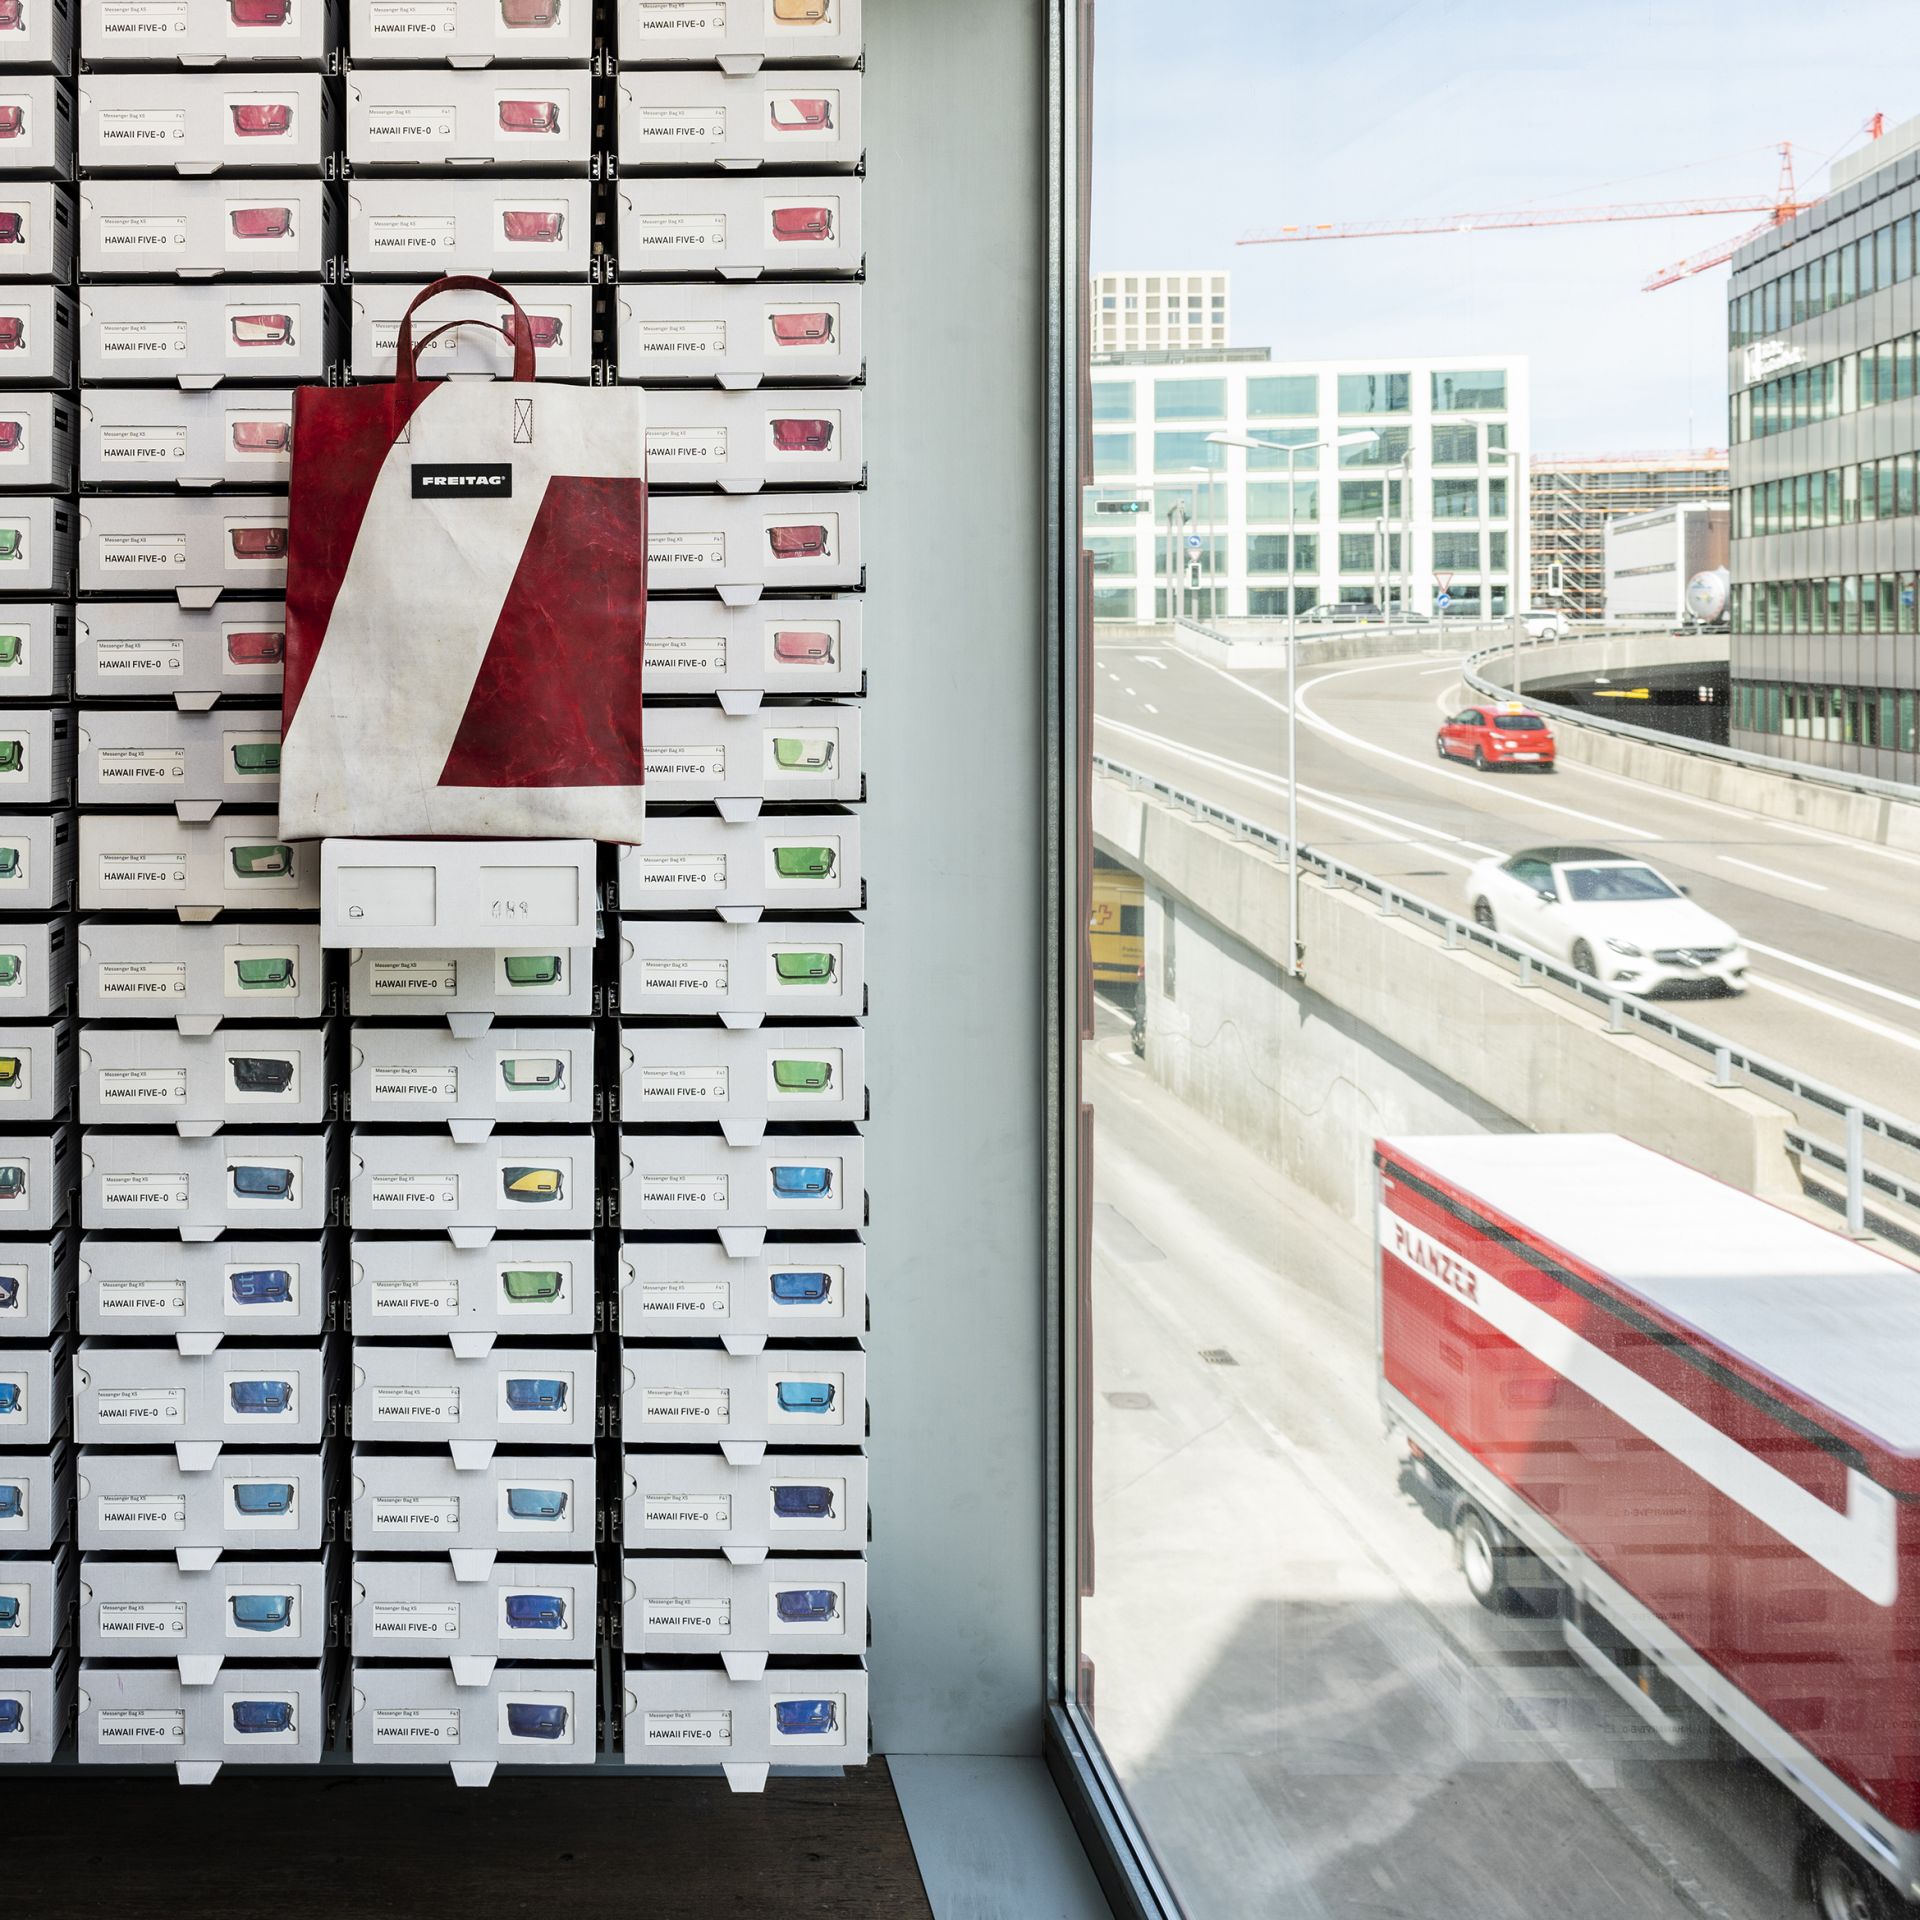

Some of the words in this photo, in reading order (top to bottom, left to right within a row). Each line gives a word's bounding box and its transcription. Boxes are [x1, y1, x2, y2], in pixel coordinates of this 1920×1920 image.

[105, 24, 136, 32] HAWAII
[643, 21, 674, 29] HAWAII
[643, 236, 674, 244] HAWAII
[422, 476, 501, 485] FREITAG
[648, 554, 672, 562] AWAII
[99, 660, 131, 668] HAWAII
[644, 875, 675, 883] HAWAII
[375, 980, 406, 988] HAWAII
[646, 979, 677, 987] HAWAII
[104, 984, 136, 992] HAWAII
[105, 1089, 136, 1097] HAWAII
[375, 1085, 407, 1093] HAWAII
[107, 1194, 138, 1202] HAWAII
[1395, 1223, 1478, 1304] PLANZER
[103, 1300, 134, 1308] HAWAII
[378, 1407, 410, 1415] HAWAII
[104, 1513, 136, 1521] HAWAII
[377, 1515, 408, 1523] HAWAII
[102, 1623, 134, 1631] HAWAII
[375, 1623, 406, 1631] HAWAII
[102, 1728, 134, 1736] HAWAII
[377, 1728, 409, 1736] HAWAII
[649, 1730, 681, 1738] HAWAII
